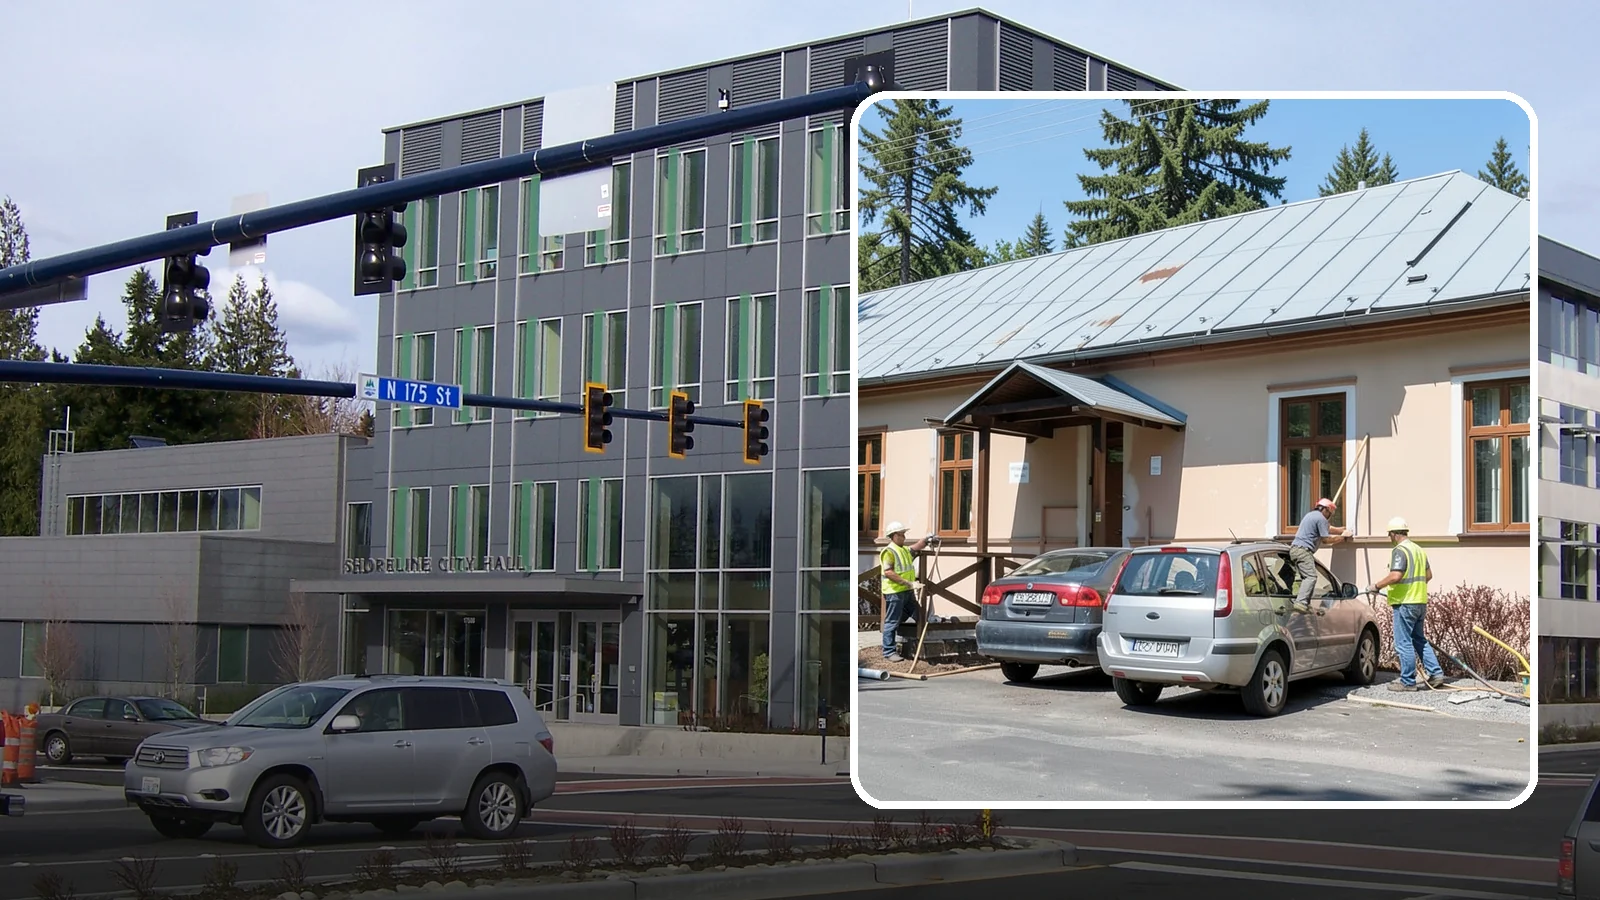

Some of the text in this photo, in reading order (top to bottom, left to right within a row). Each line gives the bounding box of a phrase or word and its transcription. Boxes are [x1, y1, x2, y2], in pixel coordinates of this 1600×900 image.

[387, 380, 451, 406] N 175 St
[344, 555, 526, 574] SHORELINE CITY HALL
